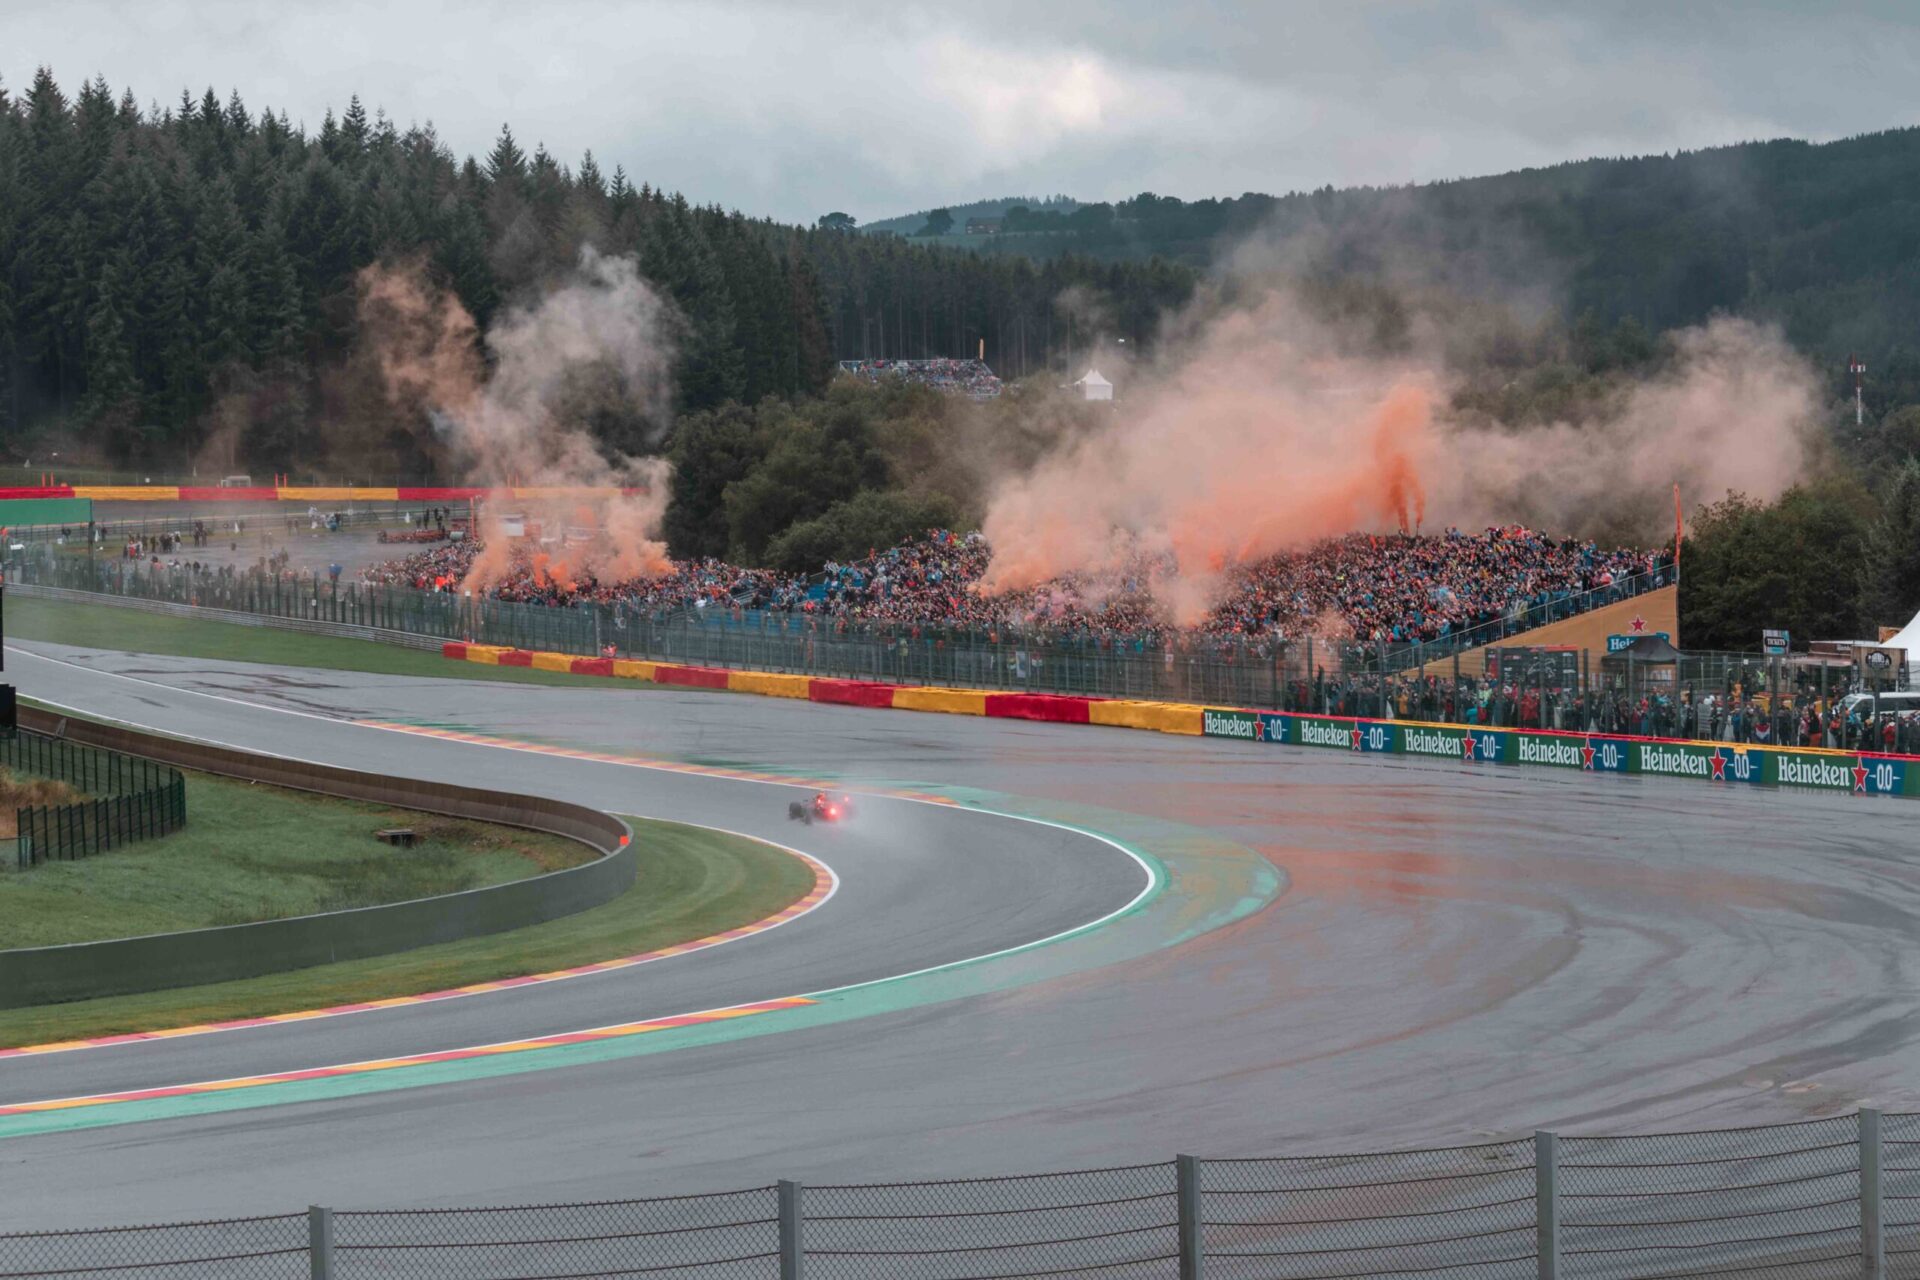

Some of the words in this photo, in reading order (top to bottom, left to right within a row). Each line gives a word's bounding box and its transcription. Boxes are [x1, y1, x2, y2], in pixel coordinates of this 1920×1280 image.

[1204, 712, 1253, 737] Heineken
[1301, 720, 1350, 746] Heineken
[1404, 729, 1461, 755] Heineken
[1518, 737, 1580, 765] Heineken
[1640, 745, 1708, 775] Heineken
[1777, 756, 1850, 786] Heineken
